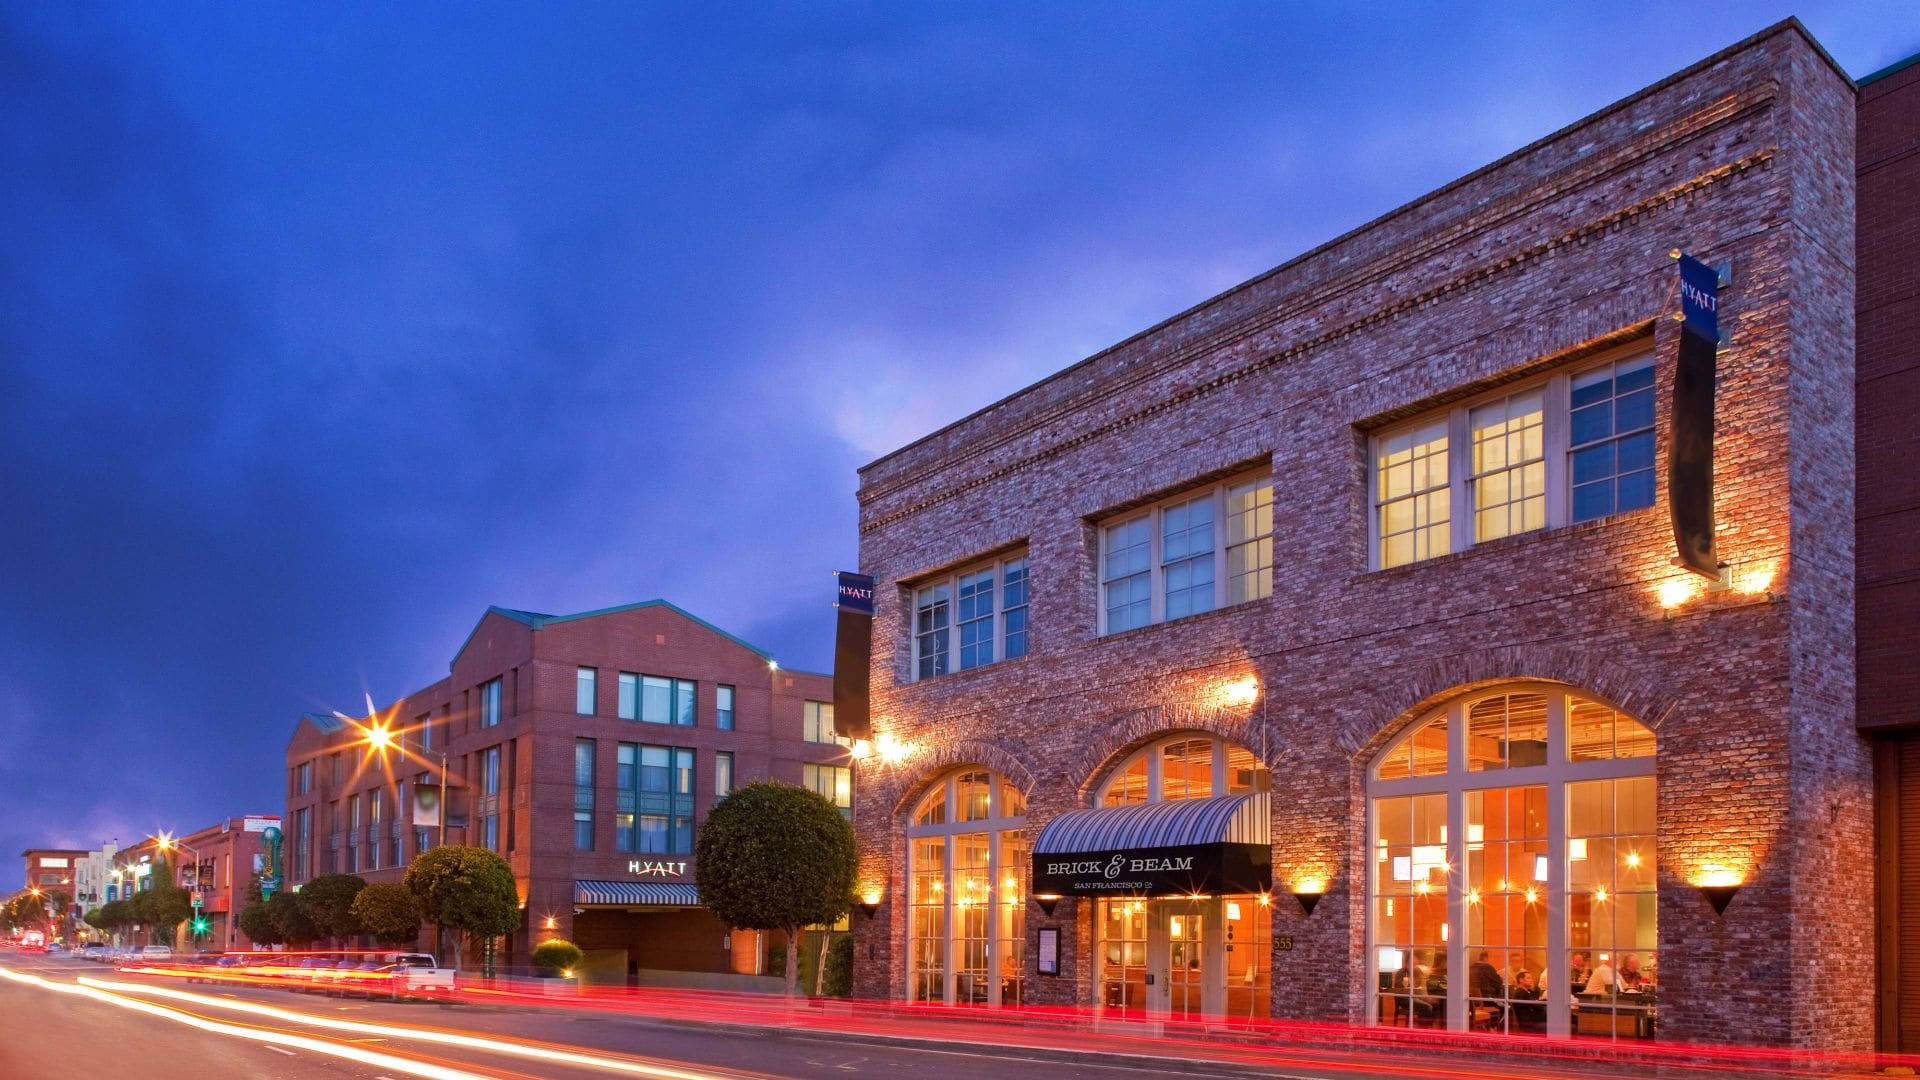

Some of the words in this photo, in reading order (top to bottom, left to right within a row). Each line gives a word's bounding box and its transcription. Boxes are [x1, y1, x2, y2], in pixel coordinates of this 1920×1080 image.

[1681, 278, 1717, 312] HYATT
[839, 585, 872, 599] HYATT
[629, 861, 686, 876] HYATT
[1047, 861, 1102, 875] BRICK
[1104, 854, 1126, 879] &
[1129, 856, 1194, 872] BEAM
[1092, 881, 1142, 889] FRANCISCO
[1274, 937, 1292, 949] 555
